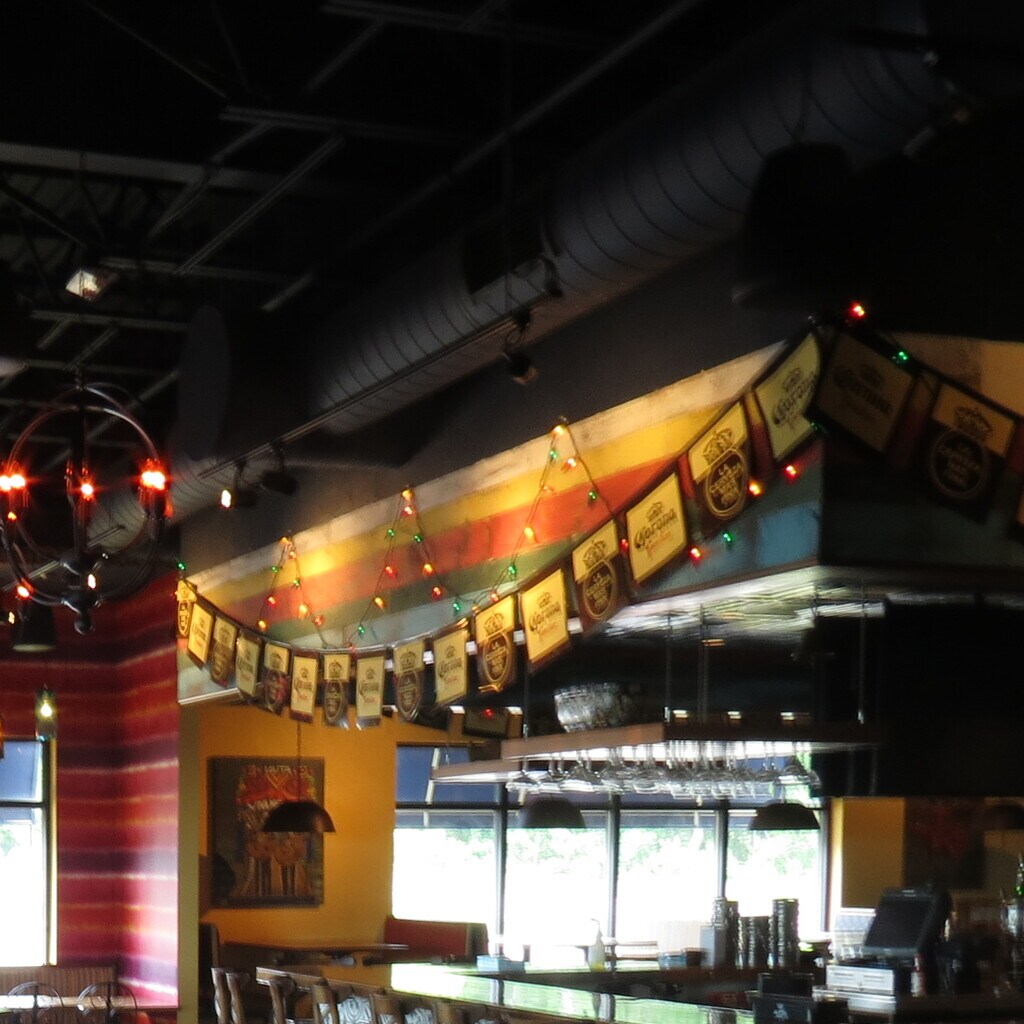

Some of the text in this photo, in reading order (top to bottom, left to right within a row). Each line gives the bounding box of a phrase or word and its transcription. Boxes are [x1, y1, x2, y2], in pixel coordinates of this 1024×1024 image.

[832, 365, 891, 415] Corona
[634, 508, 676, 550] Corona
[528, 601, 561, 633] Corona
